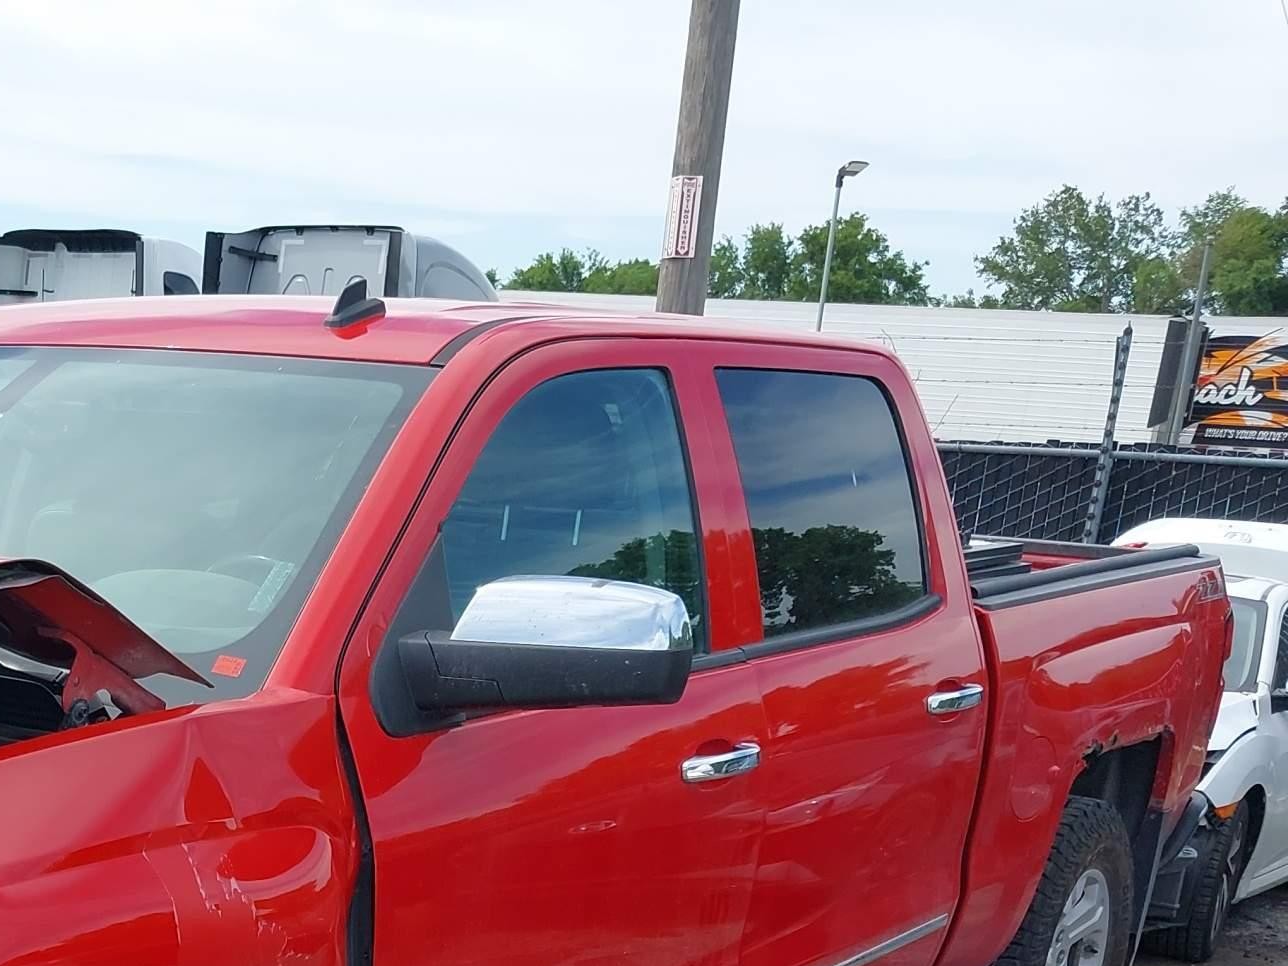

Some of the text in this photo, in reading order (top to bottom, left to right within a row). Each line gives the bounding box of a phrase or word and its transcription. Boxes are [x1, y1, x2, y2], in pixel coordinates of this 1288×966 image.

[1204, 427, 1288, 442] WHAT'S YOUR DRIVE?
